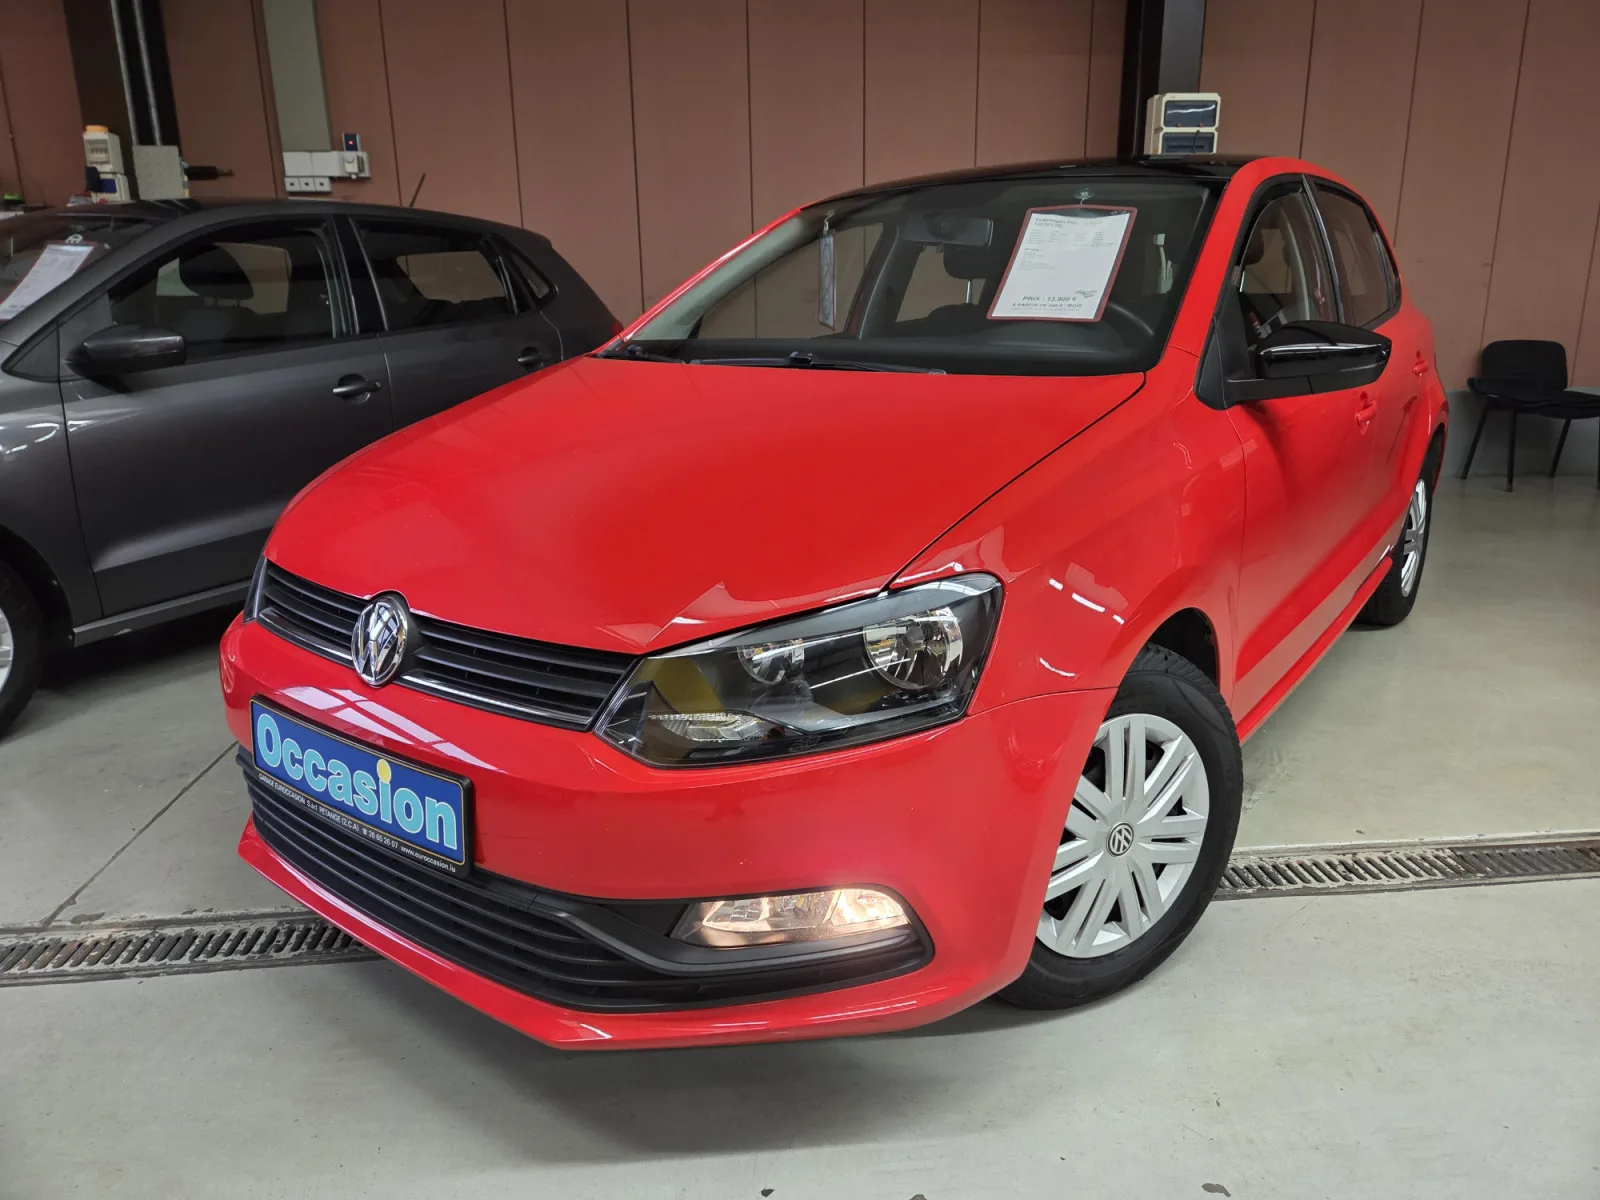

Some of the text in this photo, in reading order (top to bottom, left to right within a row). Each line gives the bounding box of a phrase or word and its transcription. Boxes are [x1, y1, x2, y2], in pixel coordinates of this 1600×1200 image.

[257, 713, 457, 850] Occasion
[274, 781, 306, 805] EUROCCASION
[400, 846, 456, 873] www.euroccasion.lu
